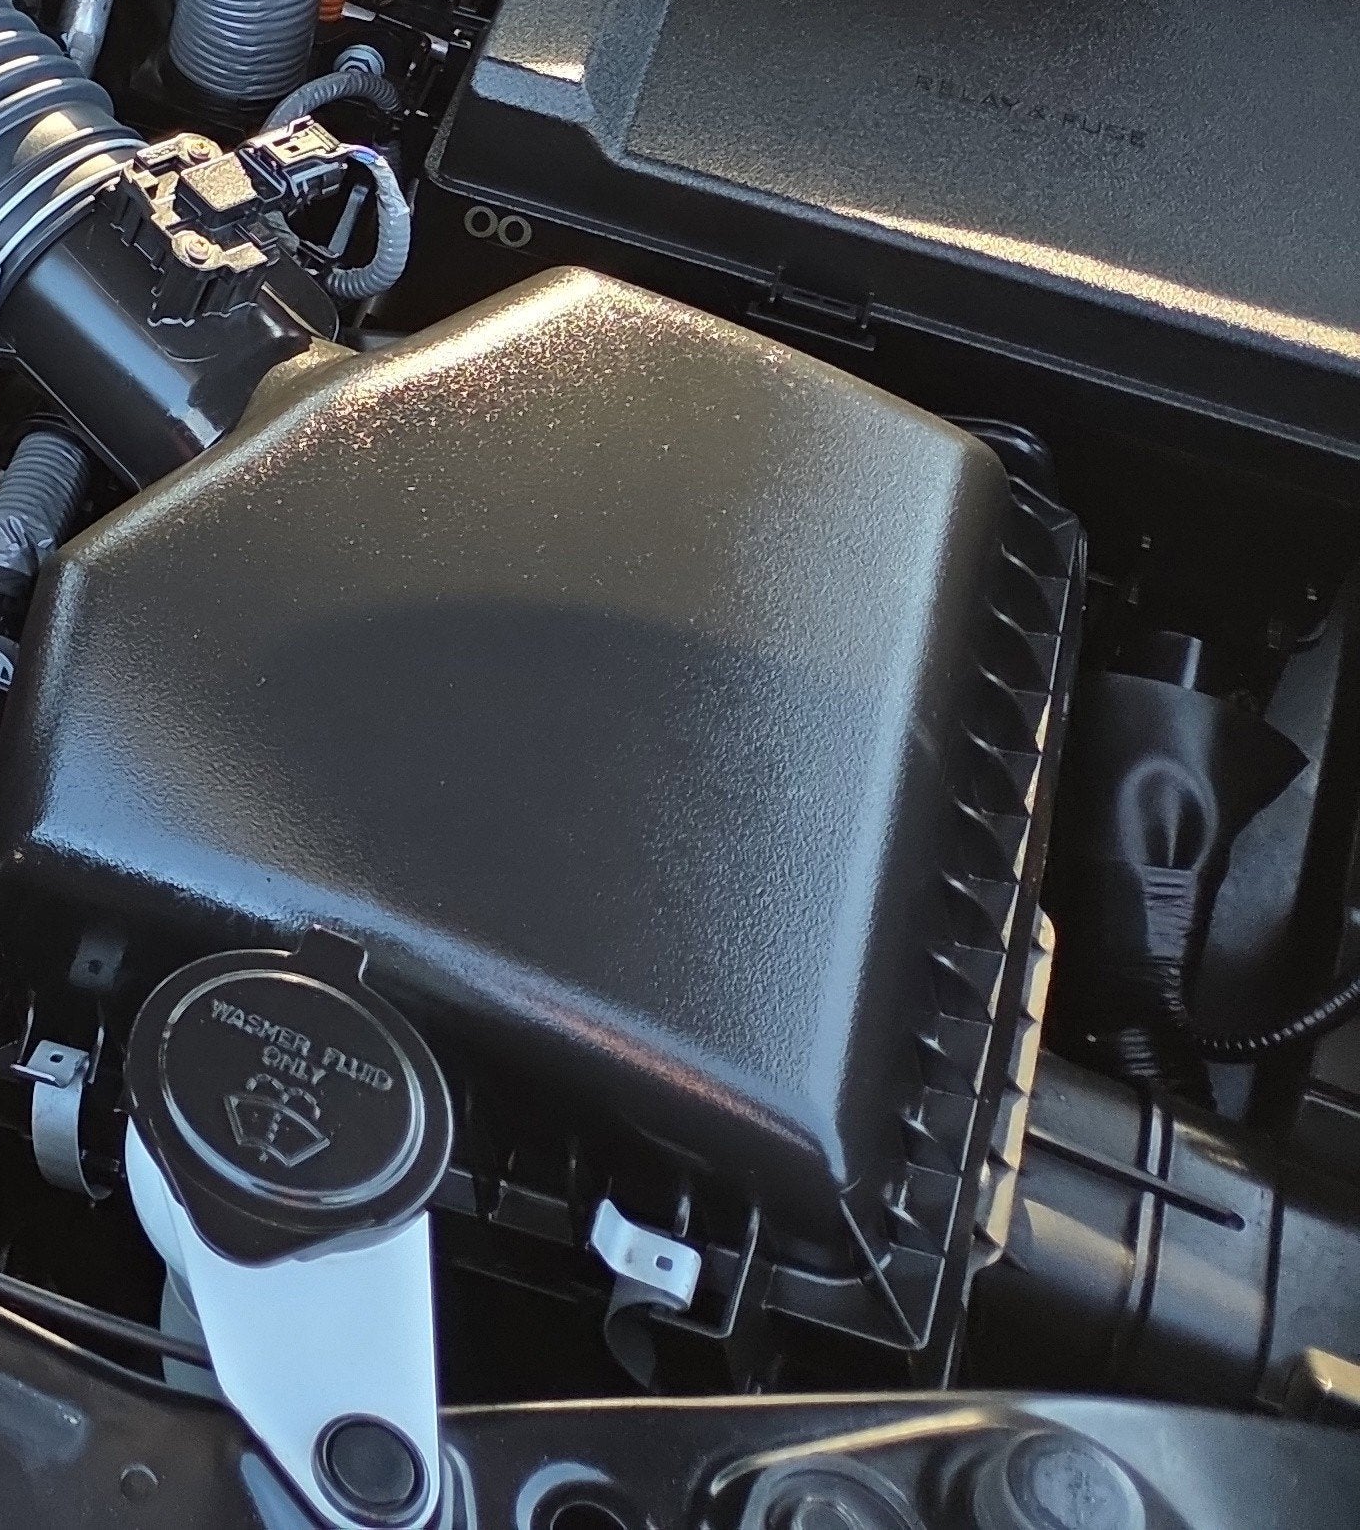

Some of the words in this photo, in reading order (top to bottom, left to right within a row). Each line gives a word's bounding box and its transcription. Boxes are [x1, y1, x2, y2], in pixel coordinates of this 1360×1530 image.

[915, 74, 1023, 112] RELAY
[1062, 112, 1149, 150] FUSE
[261, 1044, 327, 1085] ONLY
[321, 1046, 394, 1092] FLUID
